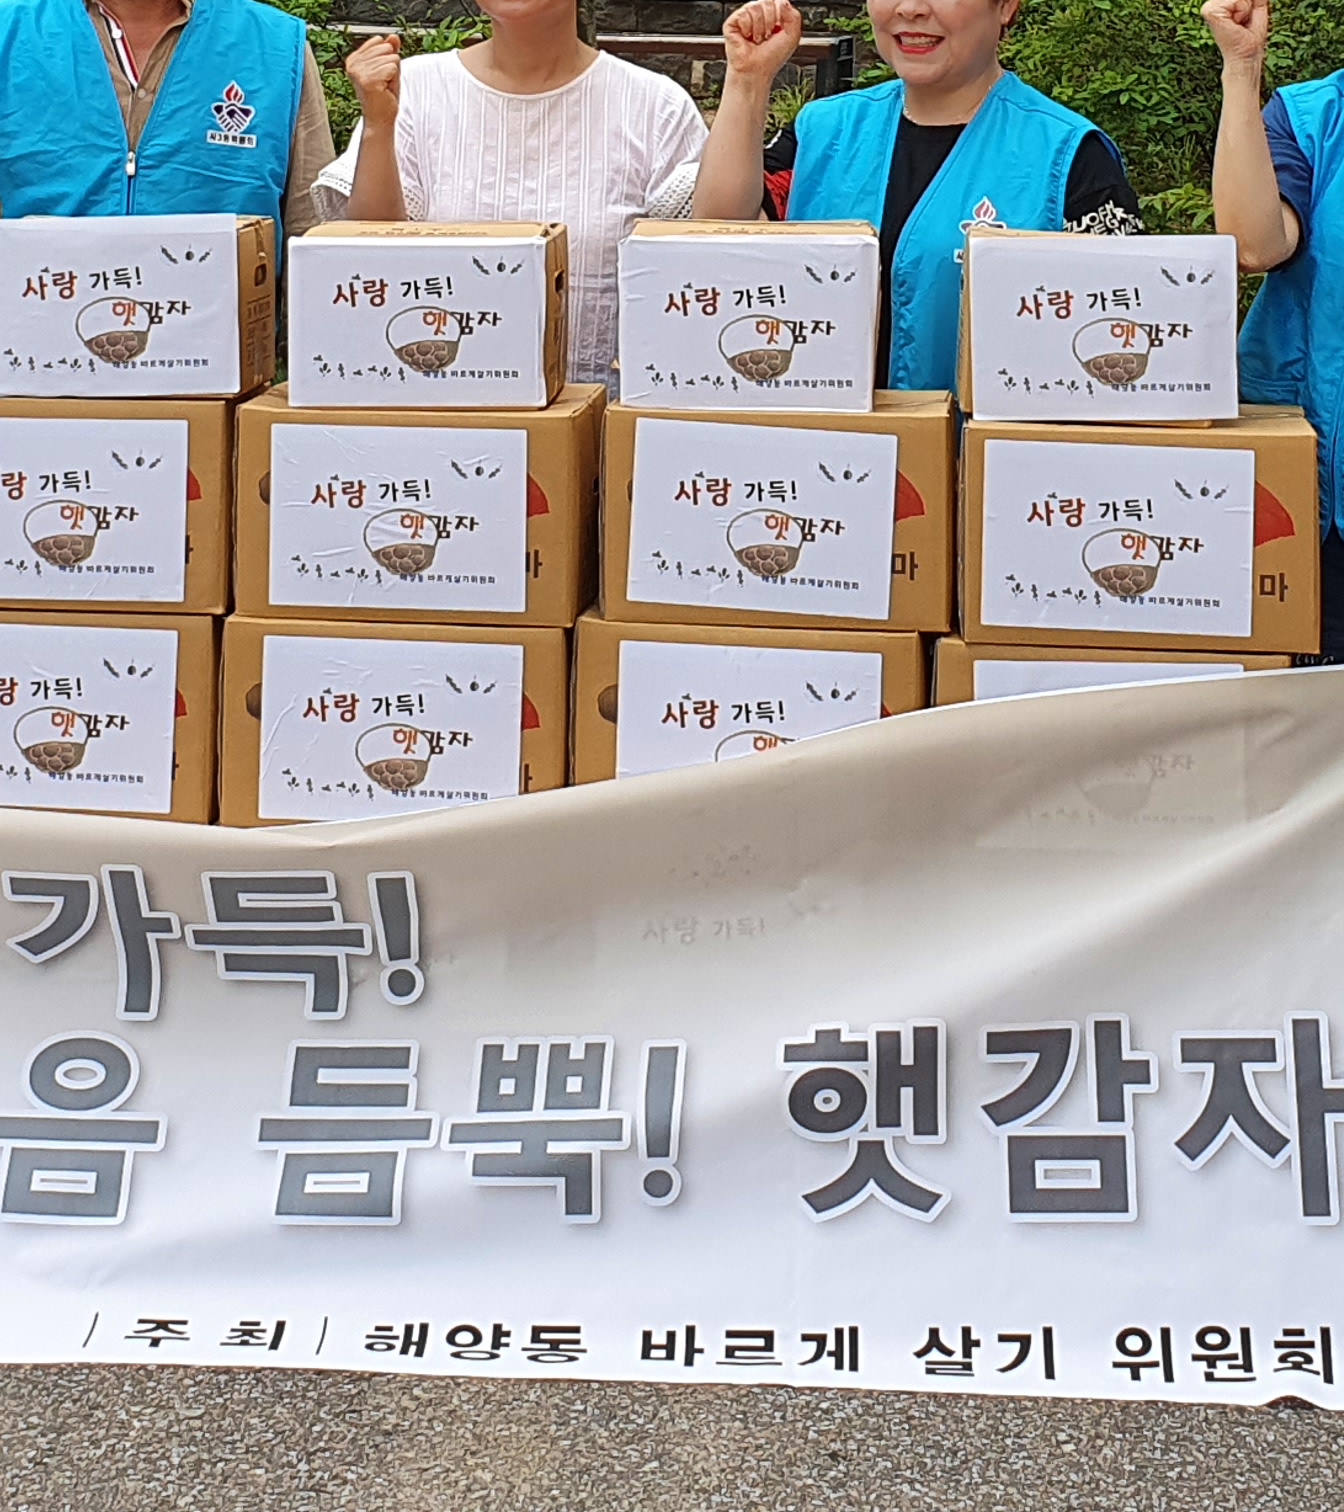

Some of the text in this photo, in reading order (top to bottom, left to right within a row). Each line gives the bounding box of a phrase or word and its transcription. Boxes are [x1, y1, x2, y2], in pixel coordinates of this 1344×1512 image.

[23, 267, 142, 300] 사랑 가득!
[333, 277, 453, 307] 사랑 가득!
[665, 286, 786, 316] 사랑 가득!
[1017, 288, 1142, 320] 사랑 가득!
[40, 470, 90, 493] 가득!
[311, 479, 430, 508] 사랑 가득!
[674, 478, 797, 506] 사랑 가득!
[1027, 498, 1154, 527] 사랑 가득!
[1259, 572, 1289, 602] 마
[31, 678, 82, 700] 가득!
[303, 694, 424, 722] 사랑 가득!
[662, 700, 785, 729] 사랑 가득!
[1, 863, 427, 1021] 가득!
[256, 1034, 687, 1226] 듬뿍!
[364, 1321, 588, 1365] 해양동
[639, 1324, 860, 1373] 바르게
[912, 1325, 1058, 1381] 살기
[1112, 1325, 1335, 1386] 위원회
